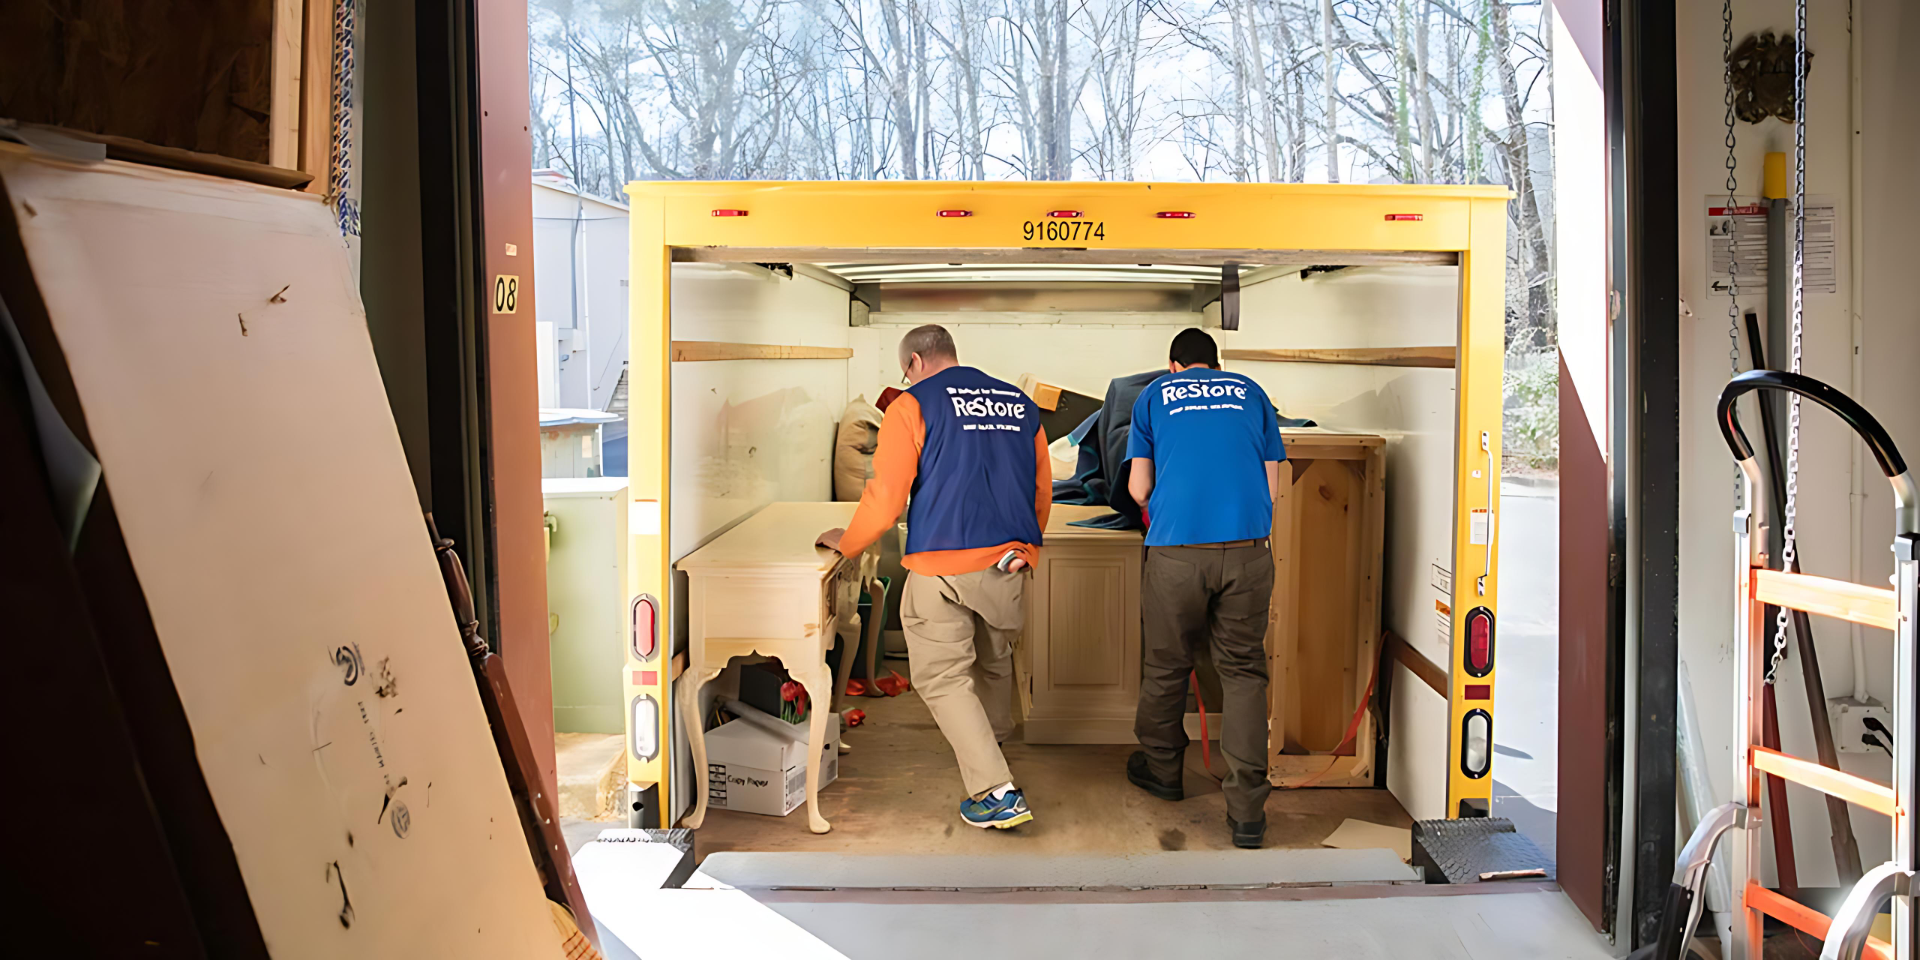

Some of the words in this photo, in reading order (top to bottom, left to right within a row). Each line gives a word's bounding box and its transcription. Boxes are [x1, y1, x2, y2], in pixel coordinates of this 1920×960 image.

[1023, 221, 1105, 241] 9160774
[495, 276, 517, 312] 08
[1161, 383, 1247, 406] ReStore
[951, 396, 1026, 419] ReStore
